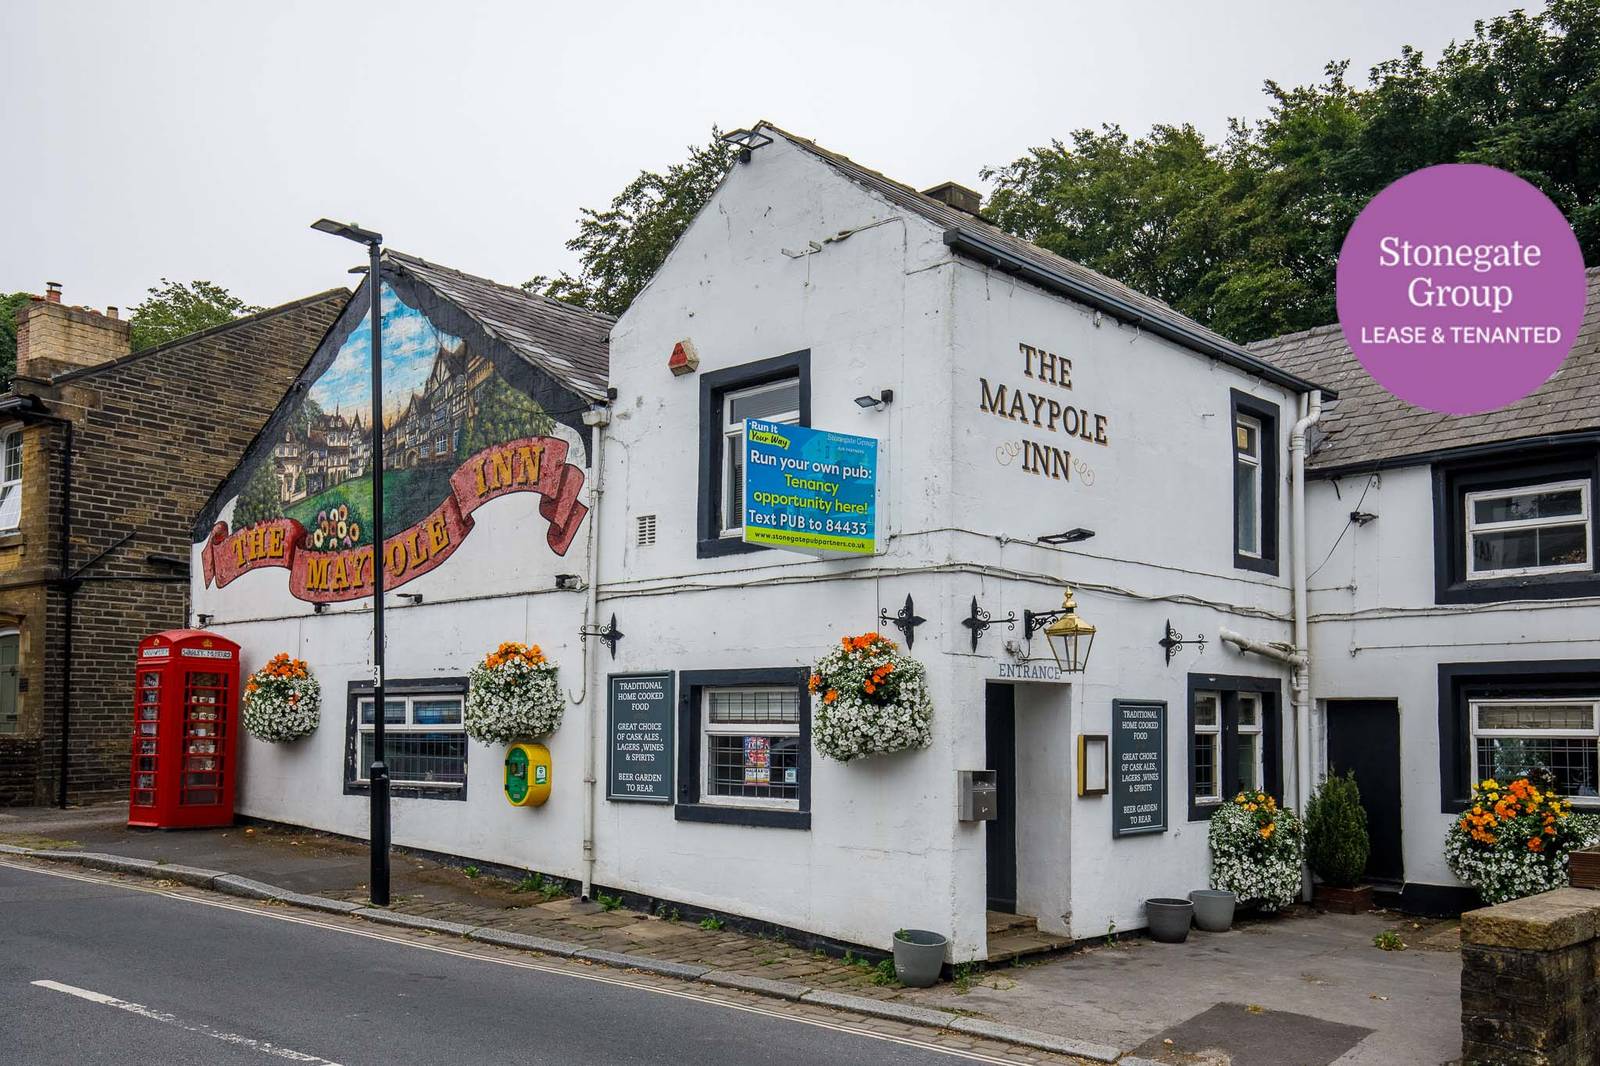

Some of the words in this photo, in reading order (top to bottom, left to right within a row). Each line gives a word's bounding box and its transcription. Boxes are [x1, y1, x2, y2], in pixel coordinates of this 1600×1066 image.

[1019, 342, 1073, 391] THE
[979, 377, 1108, 447] MAYPOLE
[751, 421, 769, 432] Run
[770, 424, 778, 433] It
[751, 431, 768, 442] Your
[770, 433, 788, 449] Way
[750, 449, 777, 466] Run
[780, 457, 810, 471] your
[812, 462, 840, 475] own
[842, 465, 872, 480] pub:
[1022, 439, 1070, 483] INN
[475, 444, 546, 498] INN
[784, 474, 840, 496] Tenancy
[753, 491, 833, 514] opportunity
[835, 499, 868, 515] here!
[749, 509, 777, 526] Text
[780, 513, 806, 529] PUB
[809, 518, 823, 531] to
[825, 519, 867, 535] 84433
[754, 531, 866, 549] www.stonegatepubpartners.co.uk
[232, 527, 286, 569] THE
[999, 663, 1061, 680] ENTRANCE
[619, 682, 663, 690] TRADITIONAL
[617, 692, 637, 701] HOME
[638, 692, 664, 700] COOKED
[631, 703, 650, 711] FOOD
[1122, 710, 1158, 719] TRADITIONAL
[617, 722, 638, 731] GREAT
[638, 722, 662, 731] CHOICE
[1121, 721, 1138, 729] HOME
[1138, 721, 1159, 729] COOKED
[616, 732, 625, 741] OF
[626, 732, 643, 741] CASK
[1133, 731, 1148, 740] FOOD
[617, 743, 640, 751] LAGERS
[625, 753, 631, 761] &
[631, 753, 655, 761] SPIRITS
[1121, 752, 1139, 761] GREAT
[1138, 752, 1157, 760] CHOICE
[1121, 763, 1129, 772] OF
[1129, 763, 1143, 771] CASK
[618, 772, 634, 781] BEER
[634, 773, 662, 782] GARDEN
[1121, 773, 1141, 782] LAGERS
[626, 783, 636, 792] TO
[636, 784, 654, 793] REAR
[1133, 783, 1153, 792] SPIRITS
[1123, 805, 1137, 814] BEER
[1136, 803, 1158, 813] GARDEN
[1130, 816, 1137, 825] TO
[1137, 814, 1152, 824] REAR
